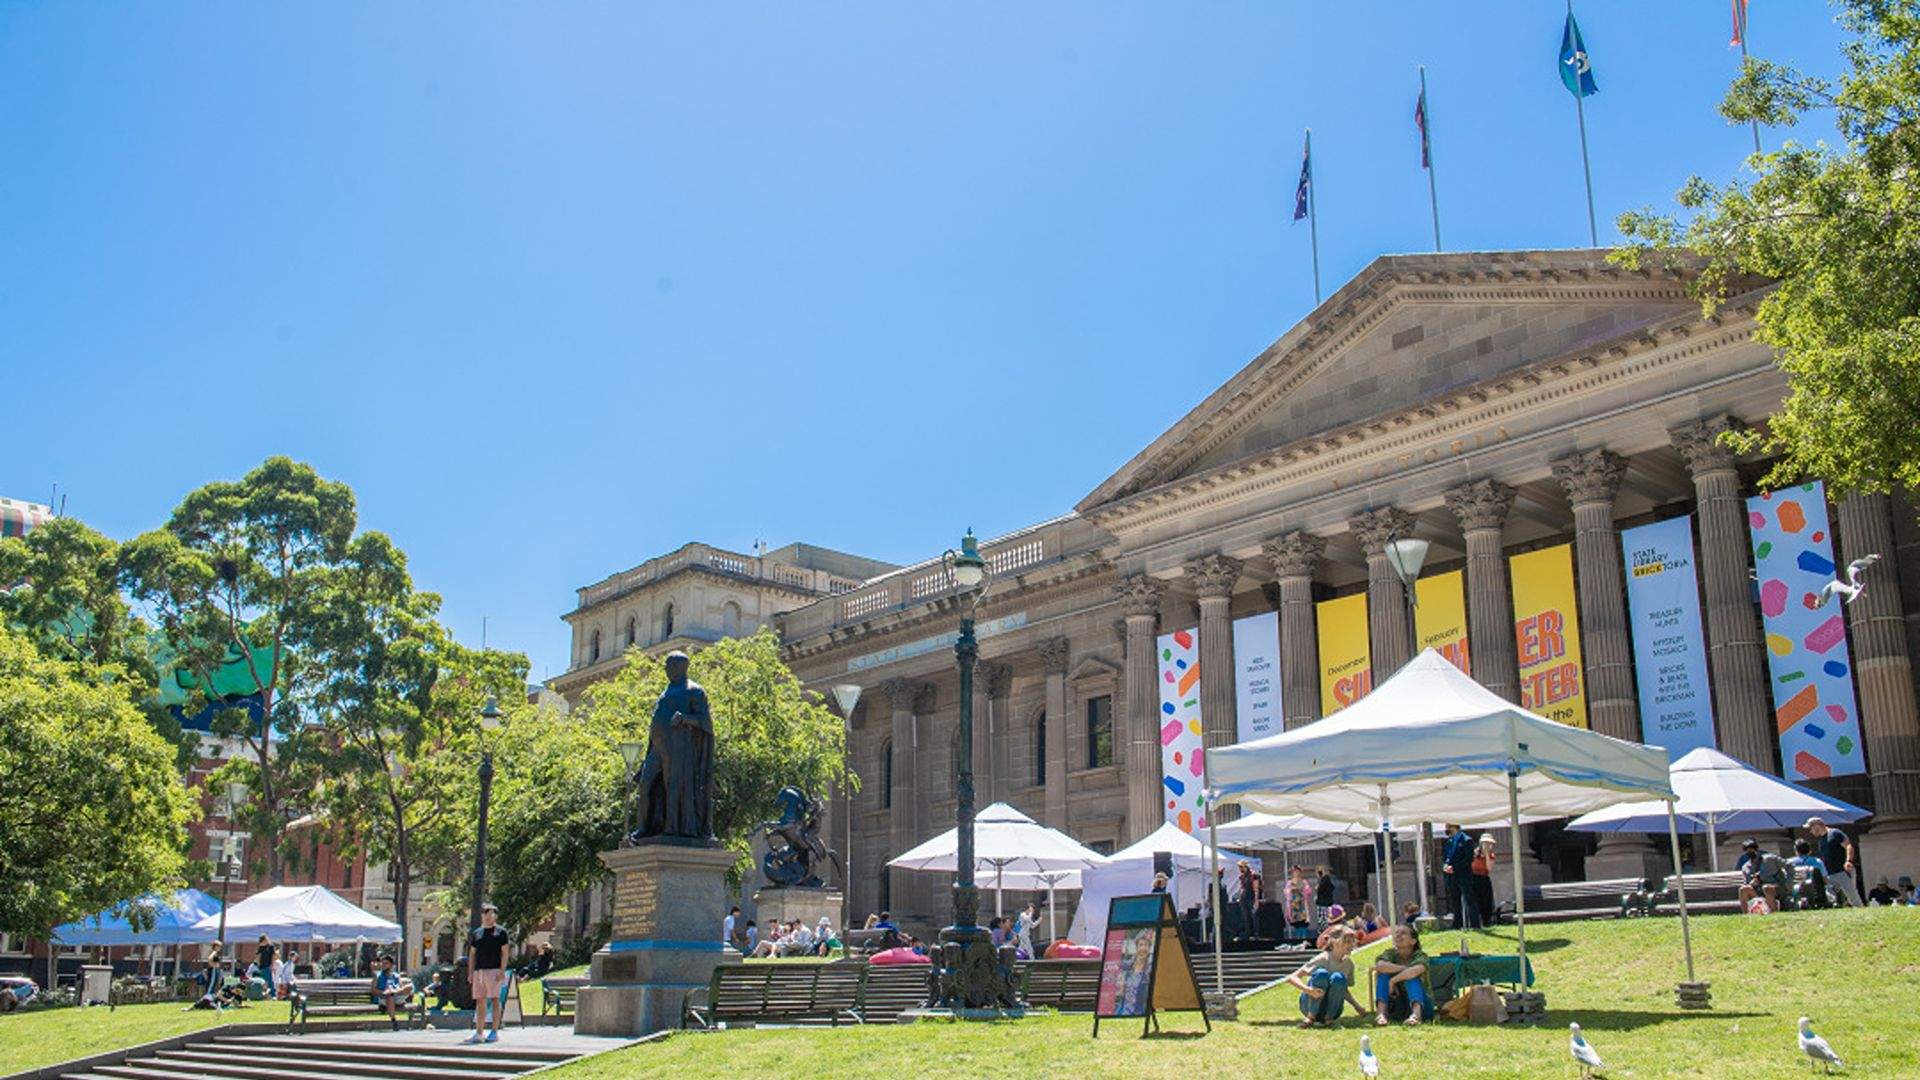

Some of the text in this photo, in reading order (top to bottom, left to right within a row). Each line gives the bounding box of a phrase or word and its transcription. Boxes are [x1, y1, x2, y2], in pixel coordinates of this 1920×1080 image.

[1632, 547, 1656, 559] STATE
[1633, 552, 1669, 567] LIBRARY
[1327, 656, 1367, 677] December
